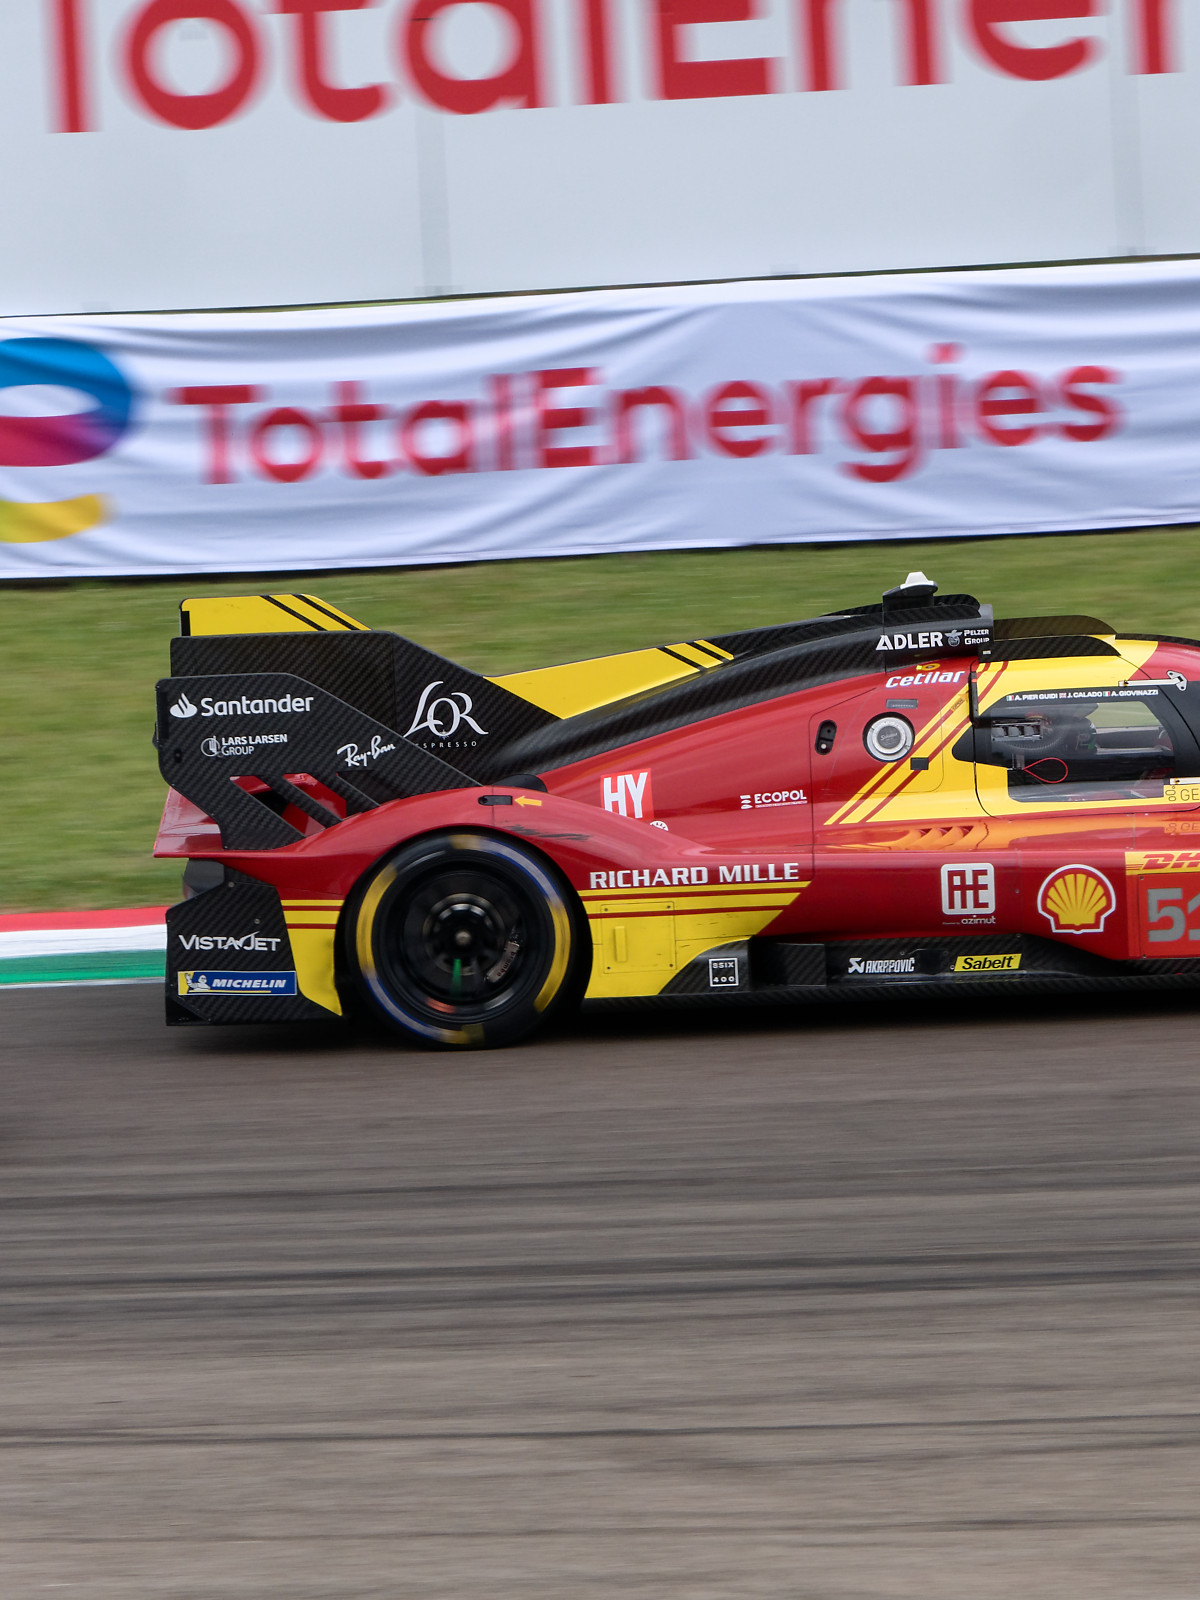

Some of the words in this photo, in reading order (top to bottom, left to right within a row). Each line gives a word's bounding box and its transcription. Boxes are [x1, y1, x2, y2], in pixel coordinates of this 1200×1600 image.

[165, 343, 1118, 483] TotalEnergies
[963, 629, 989, 637] PELZER
[876, 631, 944, 651] ADLER
[964, 637, 990, 645] GROUP
[201, 694, 314, 716] Santander
[222, 736, 248, 746] LARS
[249, 734, 288, 744] LARSEN
[415, 741, 477, 749] SPRESSO
[221, 745, 255, 756] GROUP
[336, 735, 396, 767] Ray-Ban
[603, 772, 648, 819] HY
[754, 789, 807, 804] ECOPOL
[590, 866, 708, 889] RICHARD
[718, 862, 800, 882] MILLE
[961, 915, 996, 924] azimut
[962, 956, 1015, 970] Sabelt
[212, 978, 287, 988] MICHELIN
